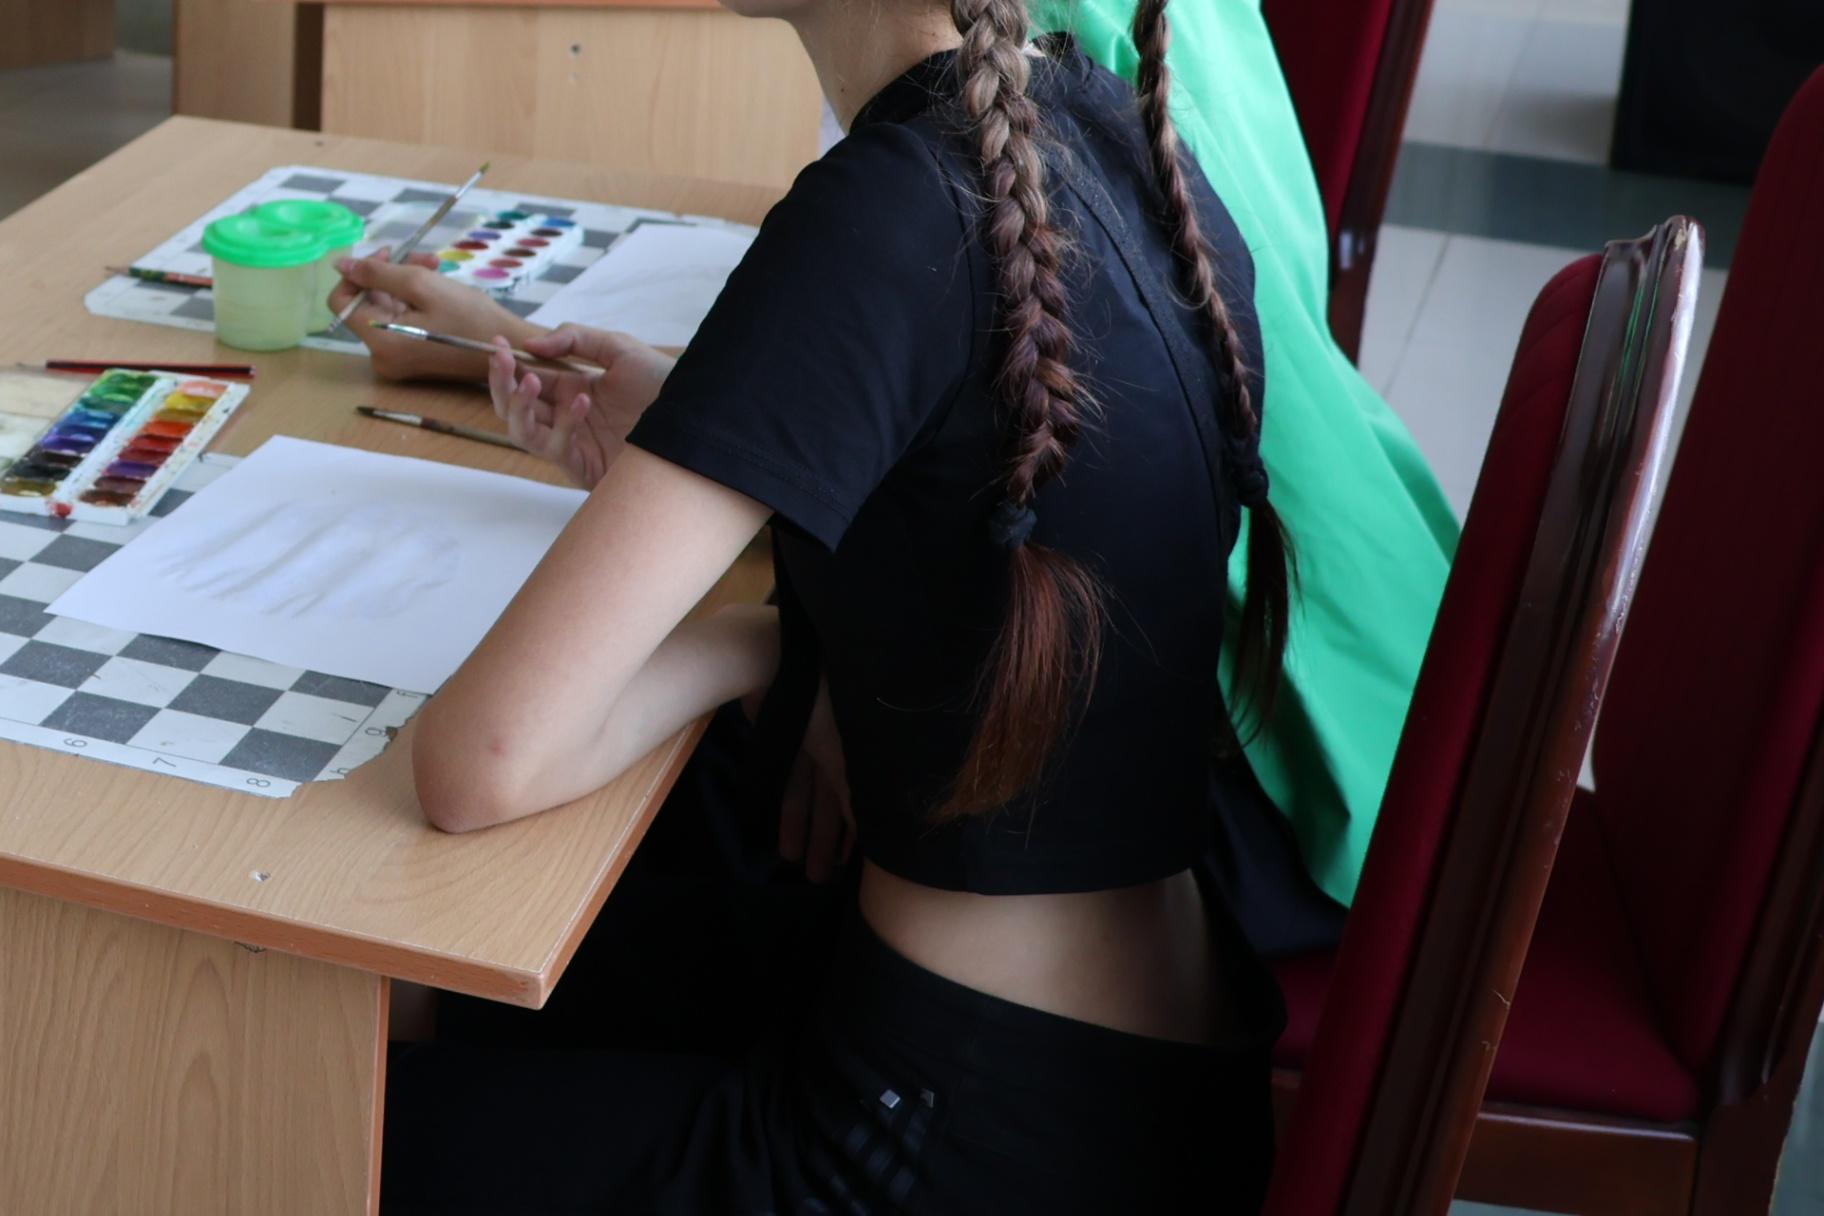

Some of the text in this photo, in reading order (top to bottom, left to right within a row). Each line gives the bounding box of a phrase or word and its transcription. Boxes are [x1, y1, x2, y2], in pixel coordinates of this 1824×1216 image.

[63, 737, 88, 748] 6
[152, 756, 176, 768] 7
[246, 776, 271, 788] 8
